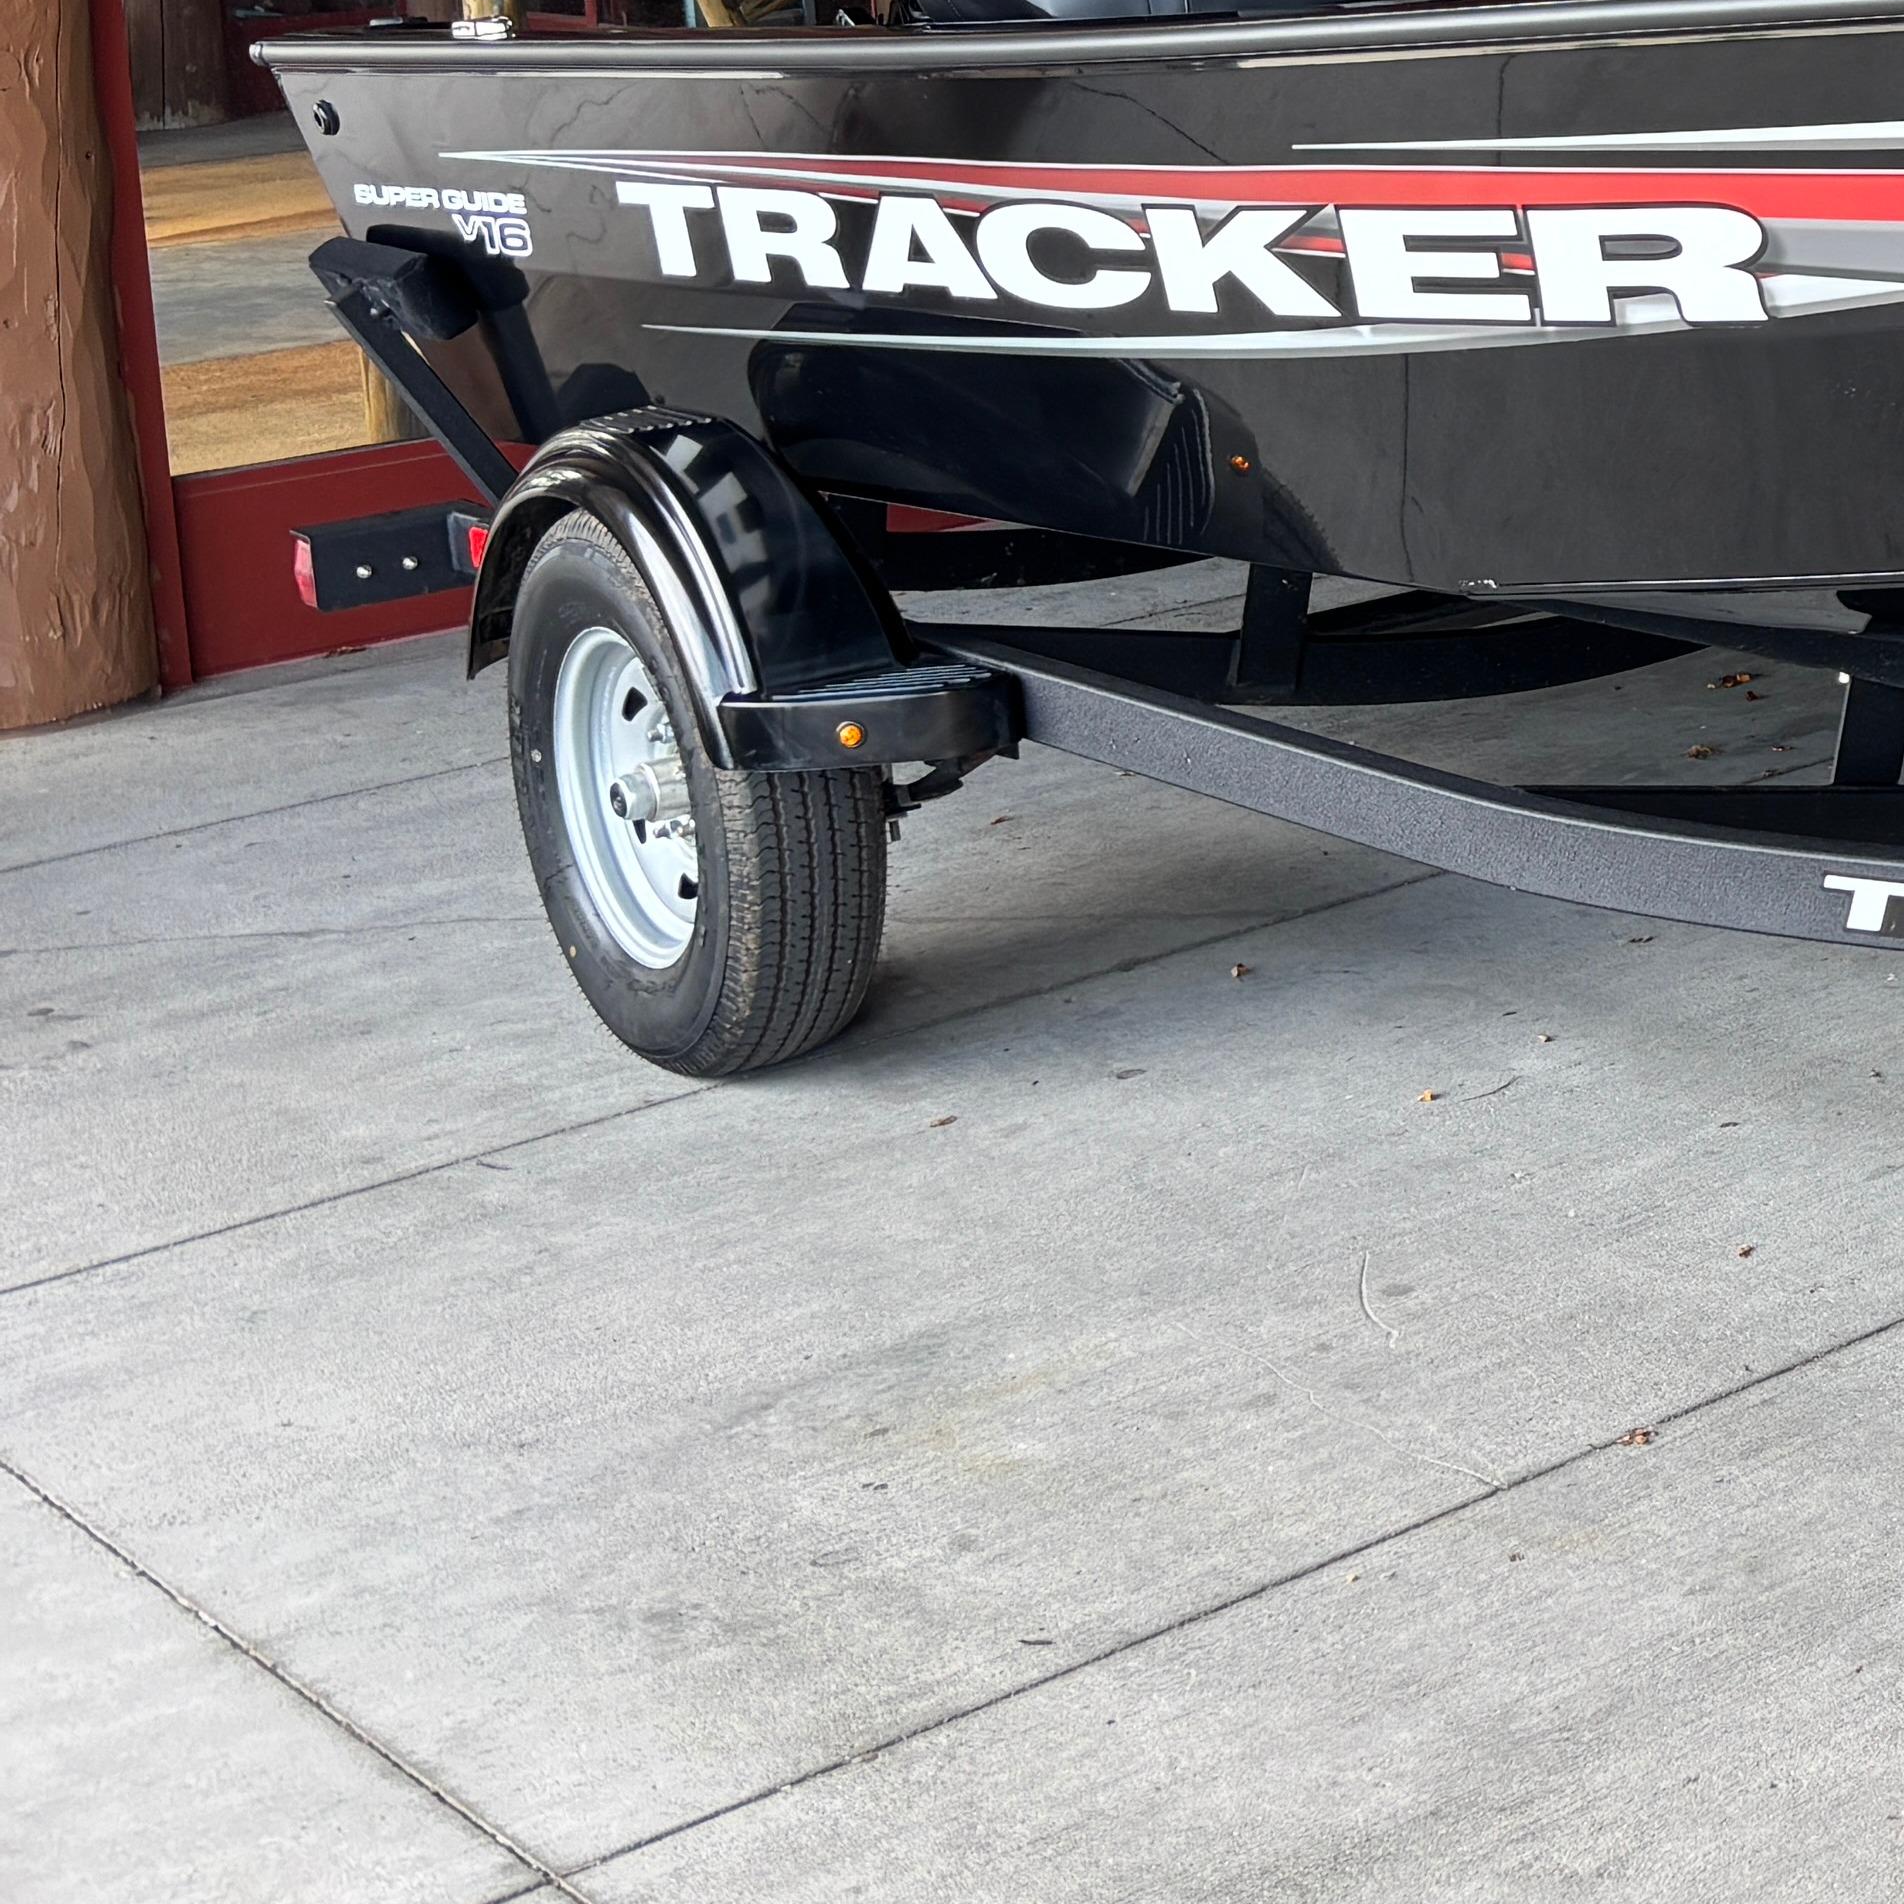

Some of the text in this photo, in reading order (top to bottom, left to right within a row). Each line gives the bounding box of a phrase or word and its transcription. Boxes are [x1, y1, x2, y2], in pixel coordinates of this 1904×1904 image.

[353, 184, 527, 215] SUPER GUIDE
[452, 213, 533, 257] V16
[616, 181, 1771, 327] TRACKER
